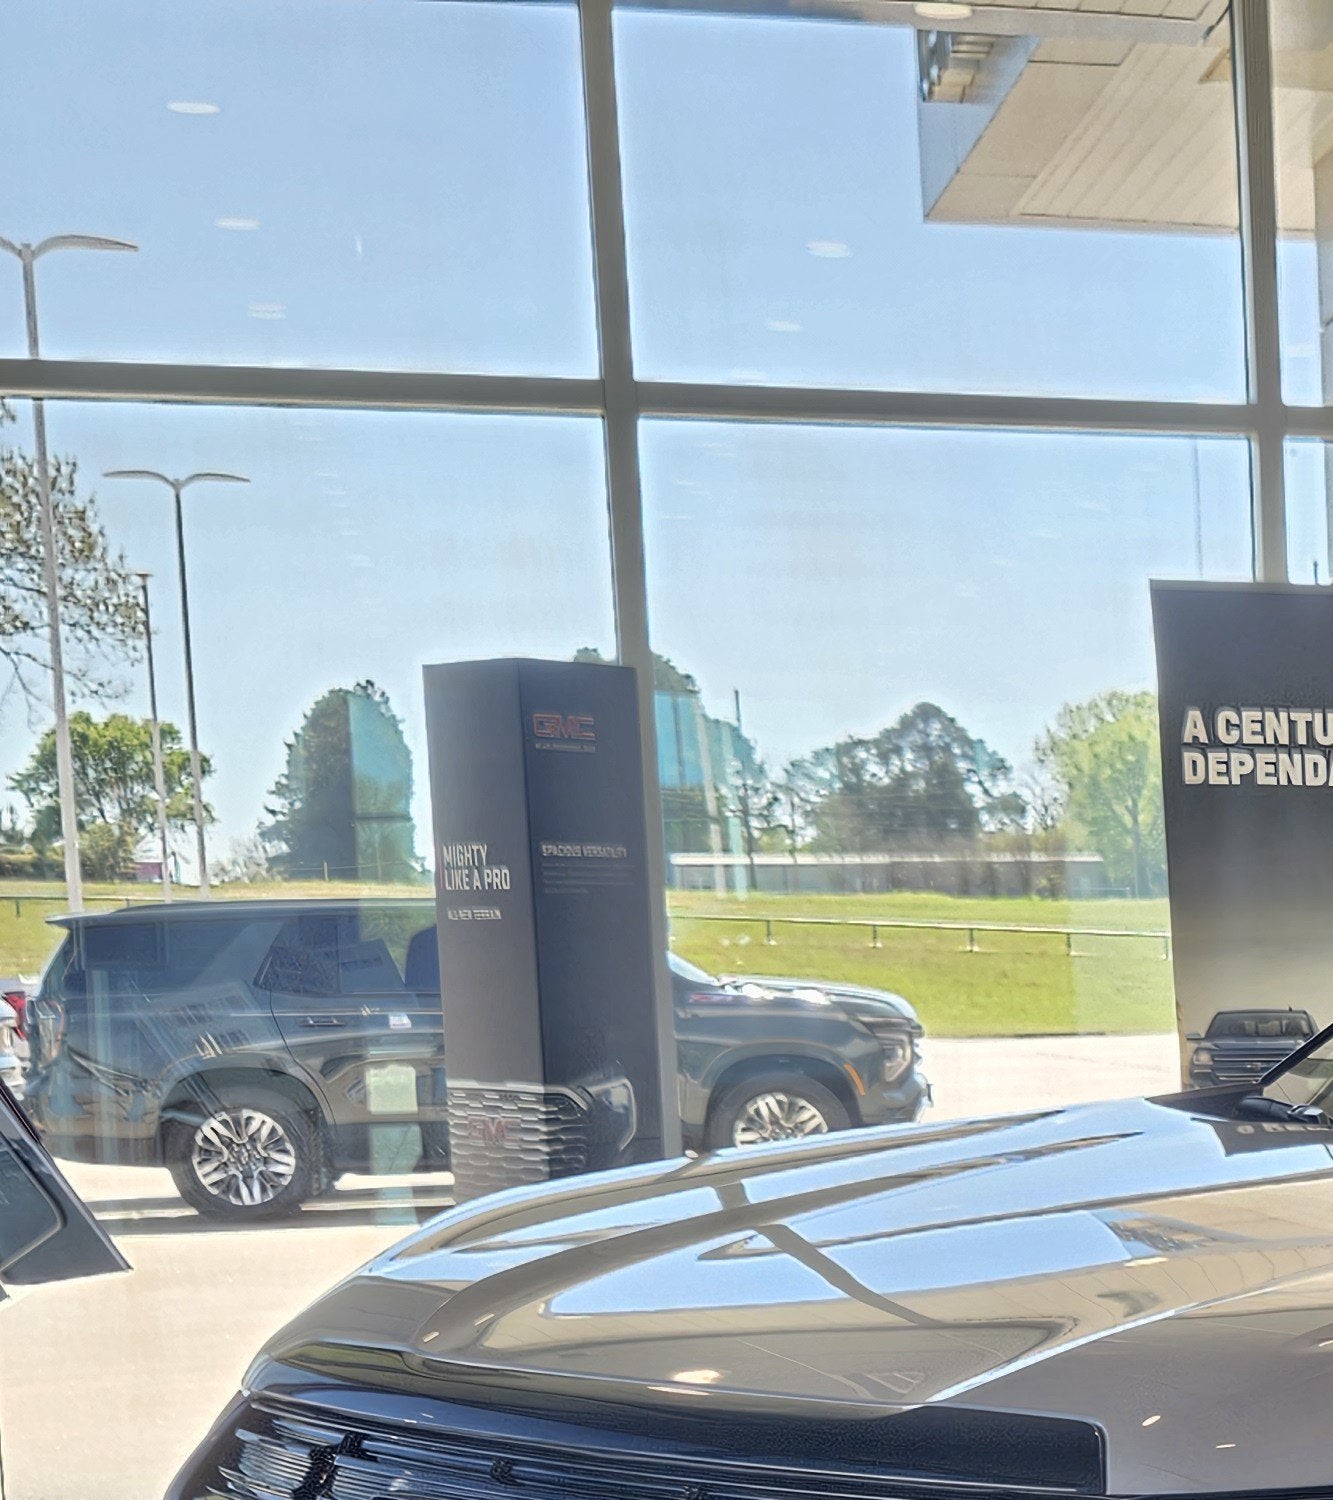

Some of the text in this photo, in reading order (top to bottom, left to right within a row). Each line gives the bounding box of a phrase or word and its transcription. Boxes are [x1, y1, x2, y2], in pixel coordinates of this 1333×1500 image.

[532, 713, 598, 741] GMC
[1182, 708, 1209, 745] A
[442, 843, 488, 868] MIGHTY
[444, 867, 512, 891] LIKE A PRO
